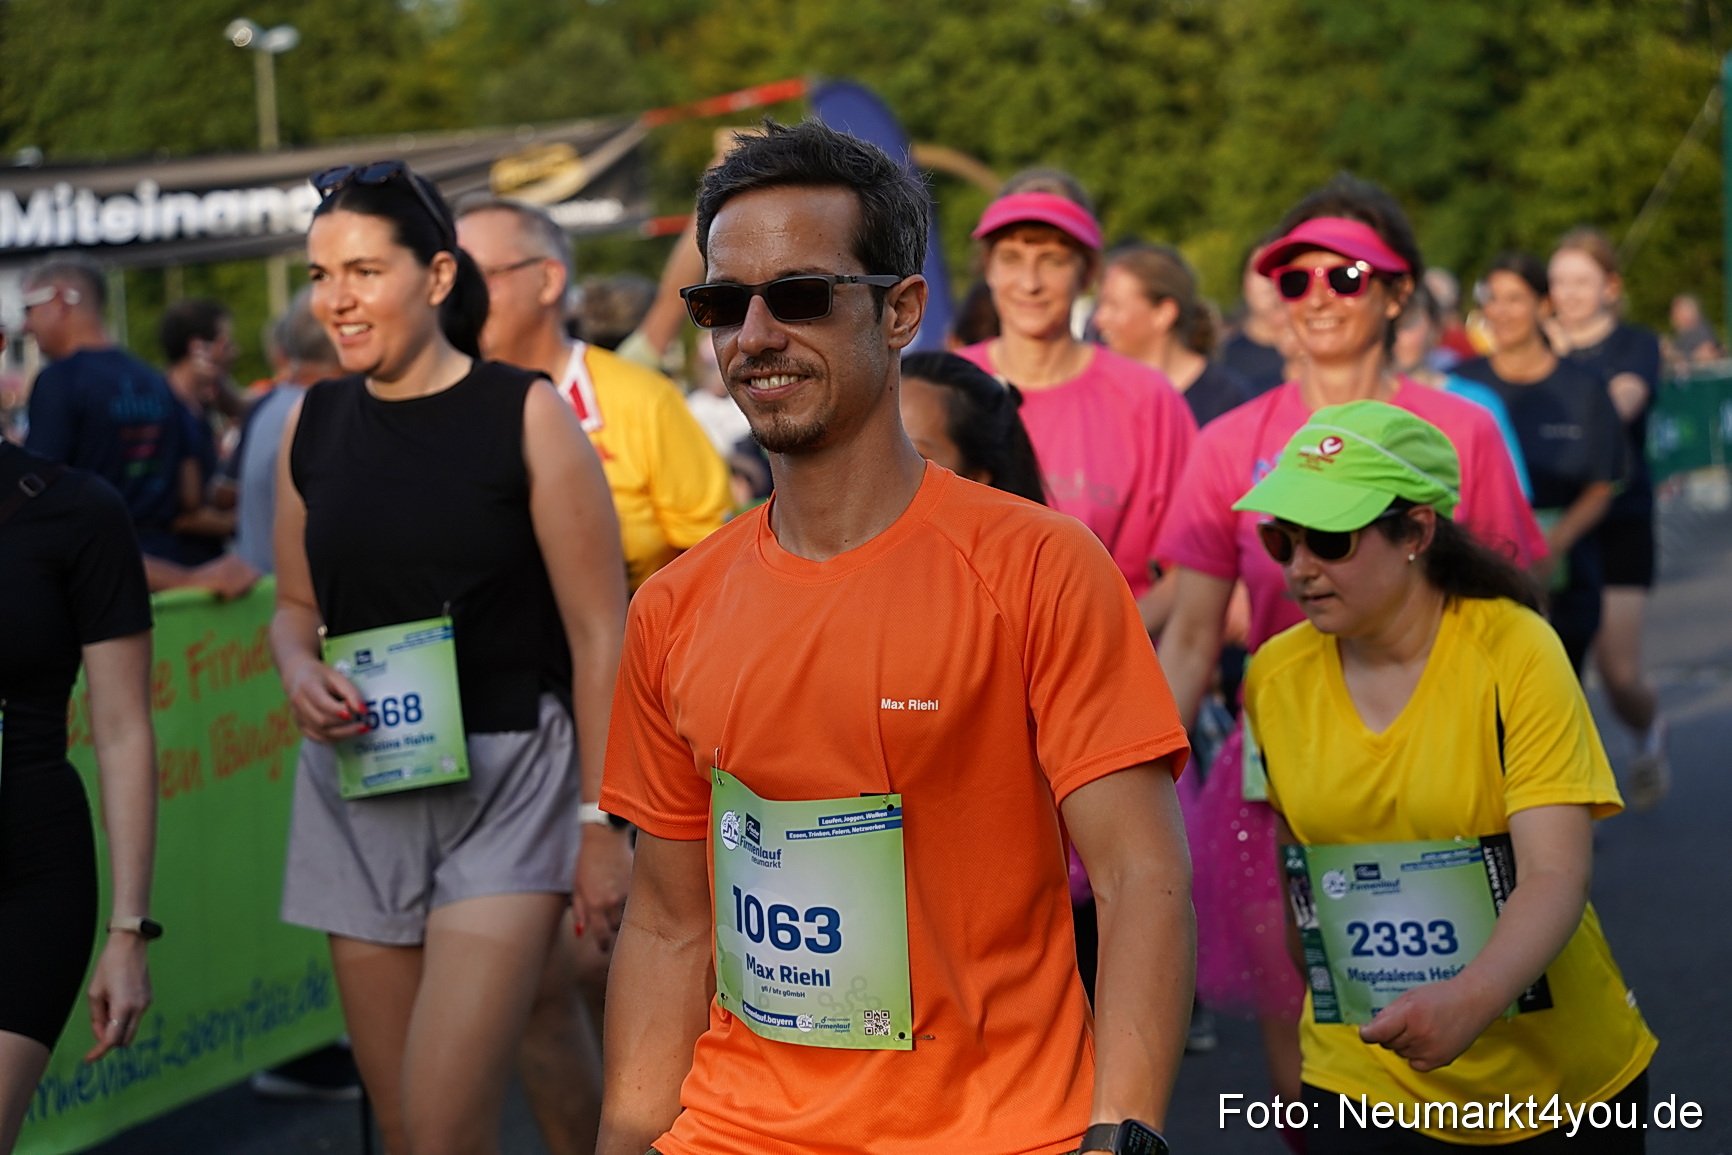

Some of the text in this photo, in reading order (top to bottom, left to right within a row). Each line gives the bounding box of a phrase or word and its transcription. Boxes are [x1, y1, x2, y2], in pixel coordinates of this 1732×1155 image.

[881, 698, 939, 711] Max Riehl
[821, 811, 888, 826] Laufen, Joggen, Walken
[788, 823, 886, 840] Essen, Trinken, Feiern, Netzwerken
[739, 834, 782, 861] Firmenlauf
[751, 856, 782, 869] neumarkt
[732, 884, 842, 954] 1063
[1346, 919, 1459, 958] 2333
[745, 952, 831, 987] Max Riehl
[1347, 967, 1427, 985] Magdalena
[815, 1022, 851, 1030] Firmenlauf
